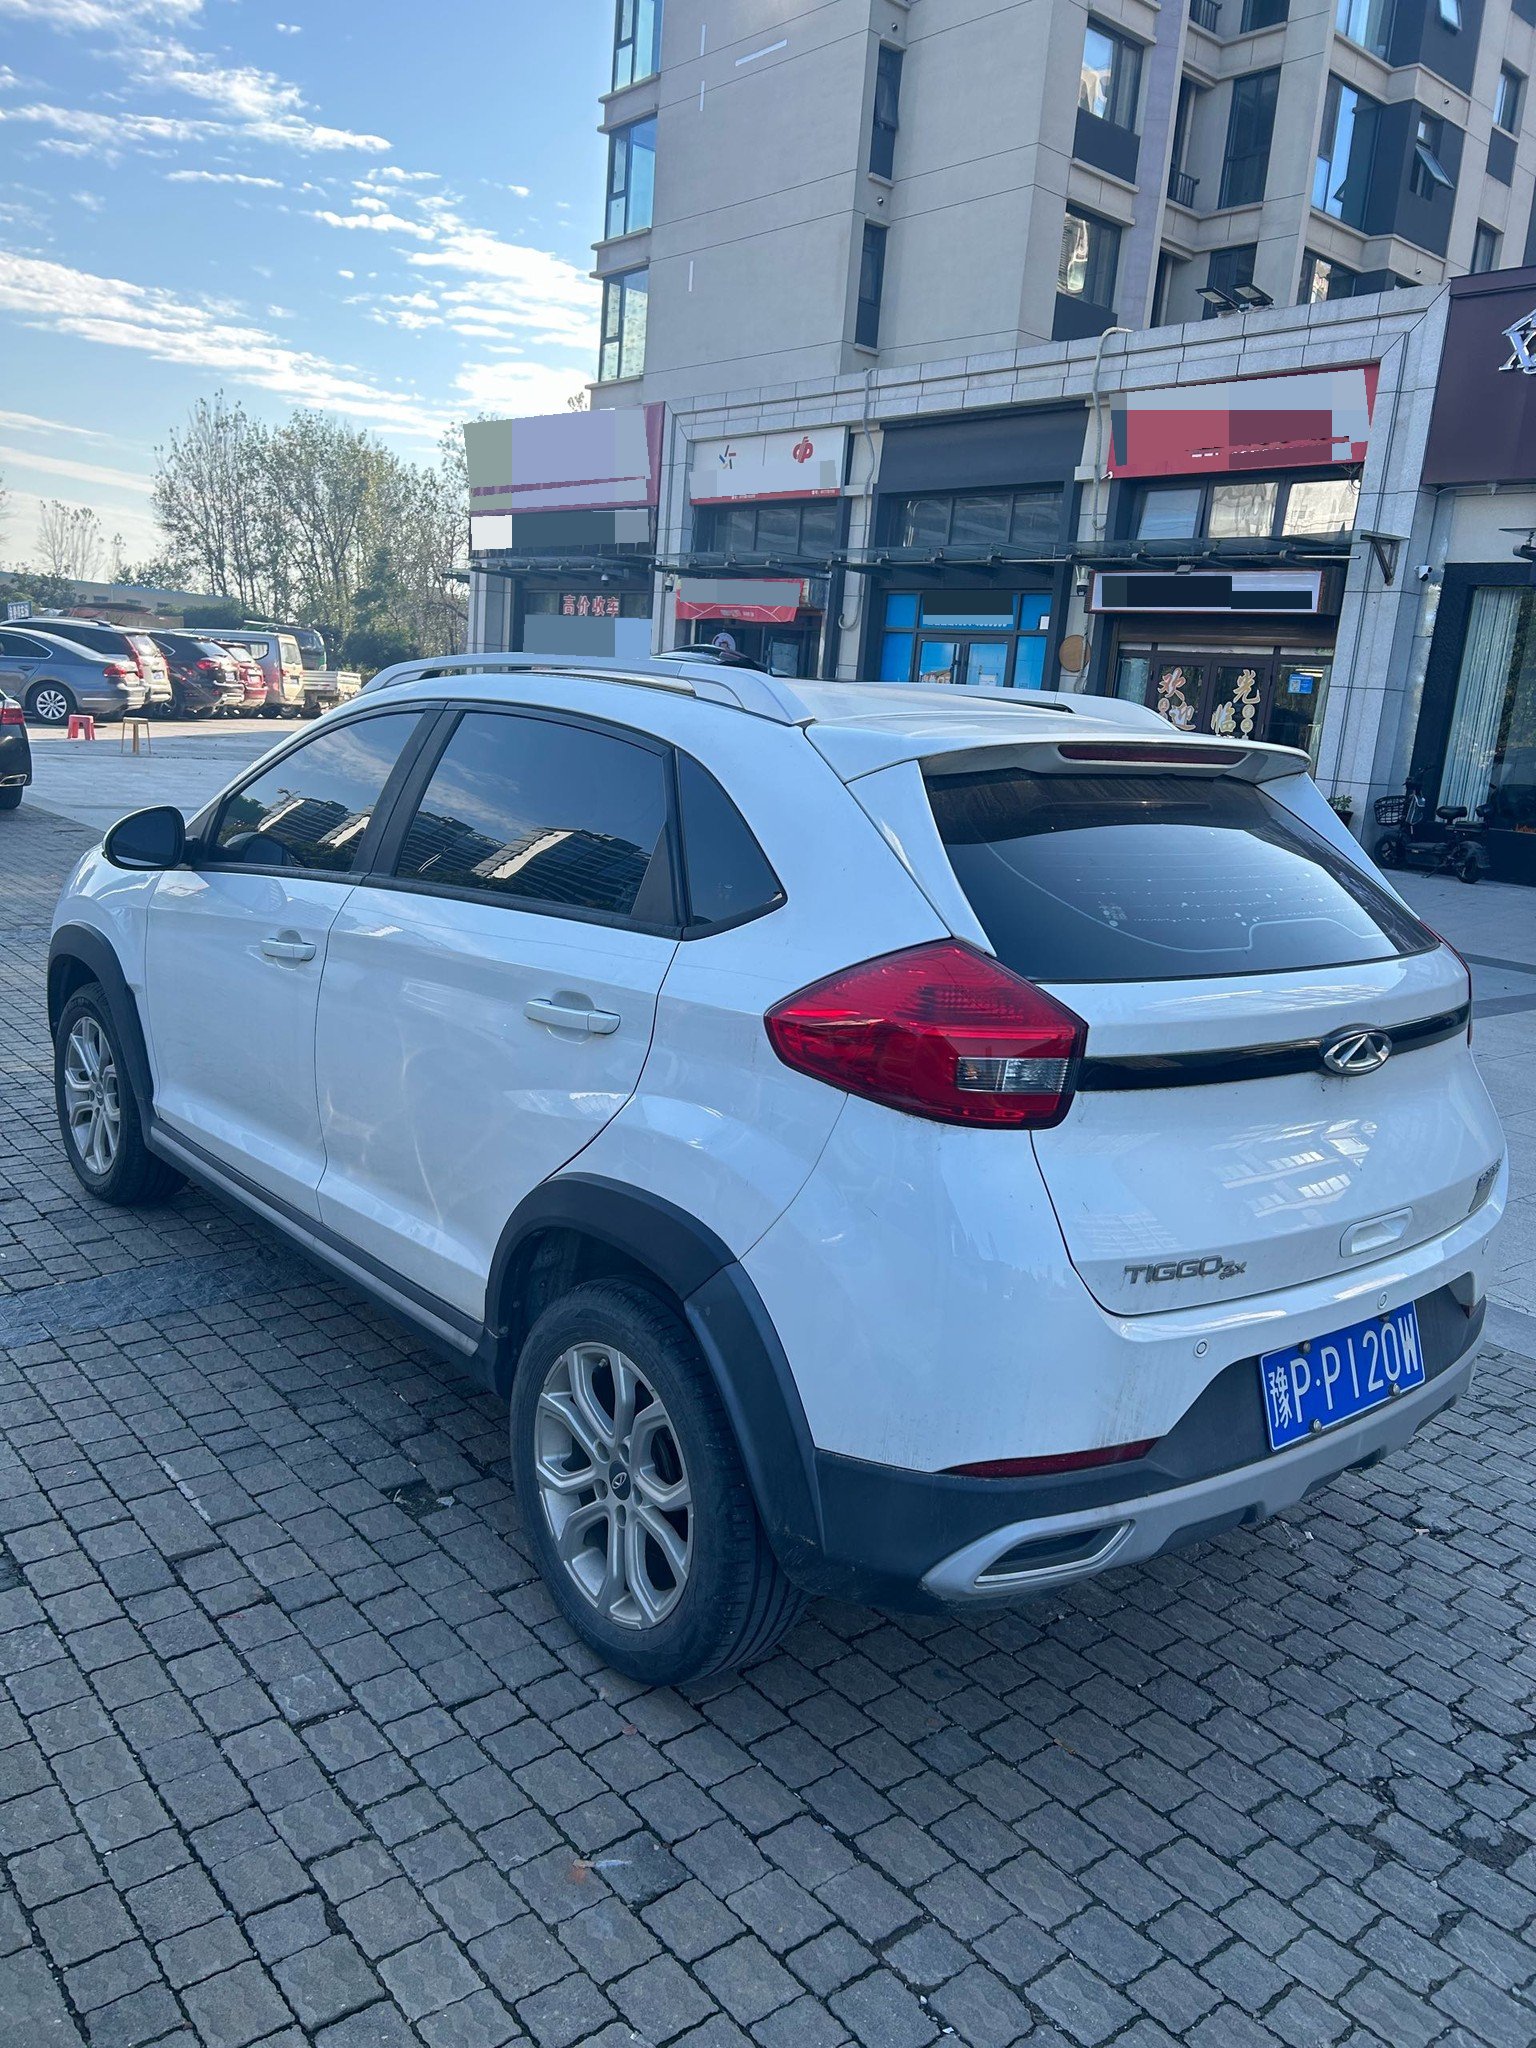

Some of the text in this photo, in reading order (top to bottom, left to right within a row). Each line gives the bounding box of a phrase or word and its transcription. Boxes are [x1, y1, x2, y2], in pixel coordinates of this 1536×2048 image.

[562, 594, 620, 618] 高价收车
[1157, 667, 1197, 731] 欢迎
[1210, 669, 1260, 735] 光临
[1124, 1254, 1223, 1284] TIGGO
